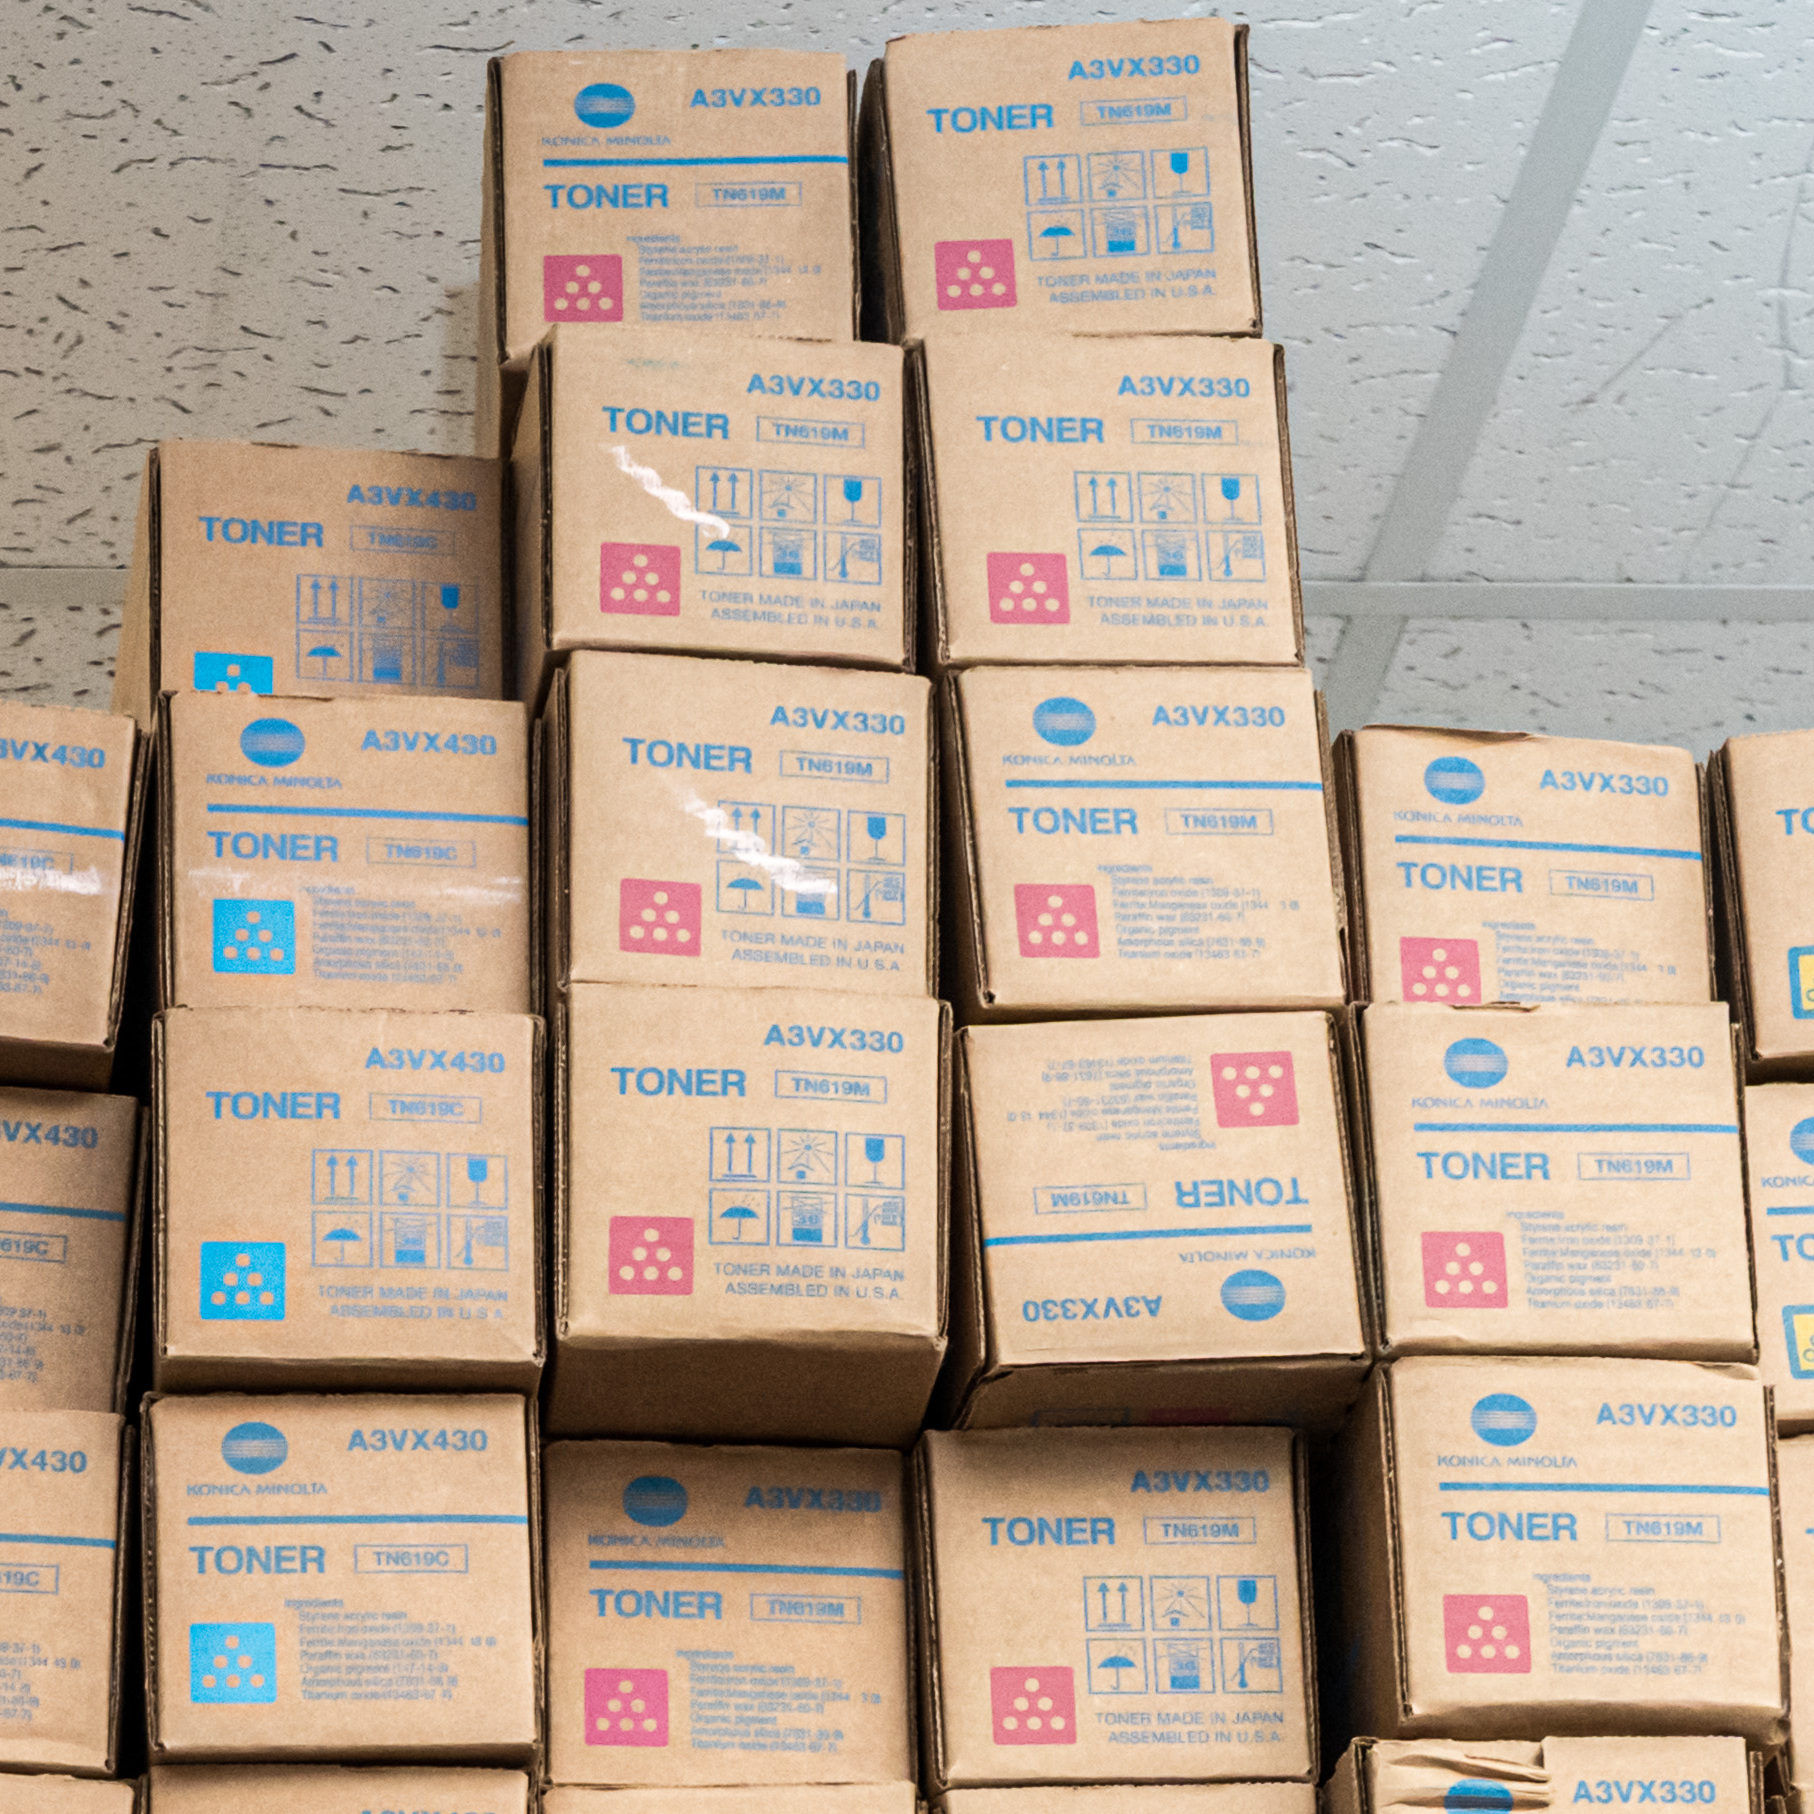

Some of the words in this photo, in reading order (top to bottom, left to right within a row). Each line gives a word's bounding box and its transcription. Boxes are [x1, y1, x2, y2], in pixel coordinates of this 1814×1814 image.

[1069, 57, 1200, 81] A3VX330
[691, 88, 822, 109] A3VX330
[927, 104, 1055, 134] TONER
[544, 184, 670, 211] TONER
[771, 707, 906, 736] A3VX330
[363, 731, 498, 756] A3VX430
[623, 738, 753, 775] TONER
[1542, 771, 1669, 798] A3VX330
[208, 832, 339, 863] TONER
[1398, 863, 1523, 894] TONER
[1598, 1404, 1737, 1429] A3VX330
[1132, 1470, 1271, 1494] A3VX330
[982, 1517, 1116, 1547] TONER
[1162, 1521, 1240, 1540] TN619M
[1442, 1513, 1578, 1542] TONER
[1625, 1518, 1704, 1538] TN619M
